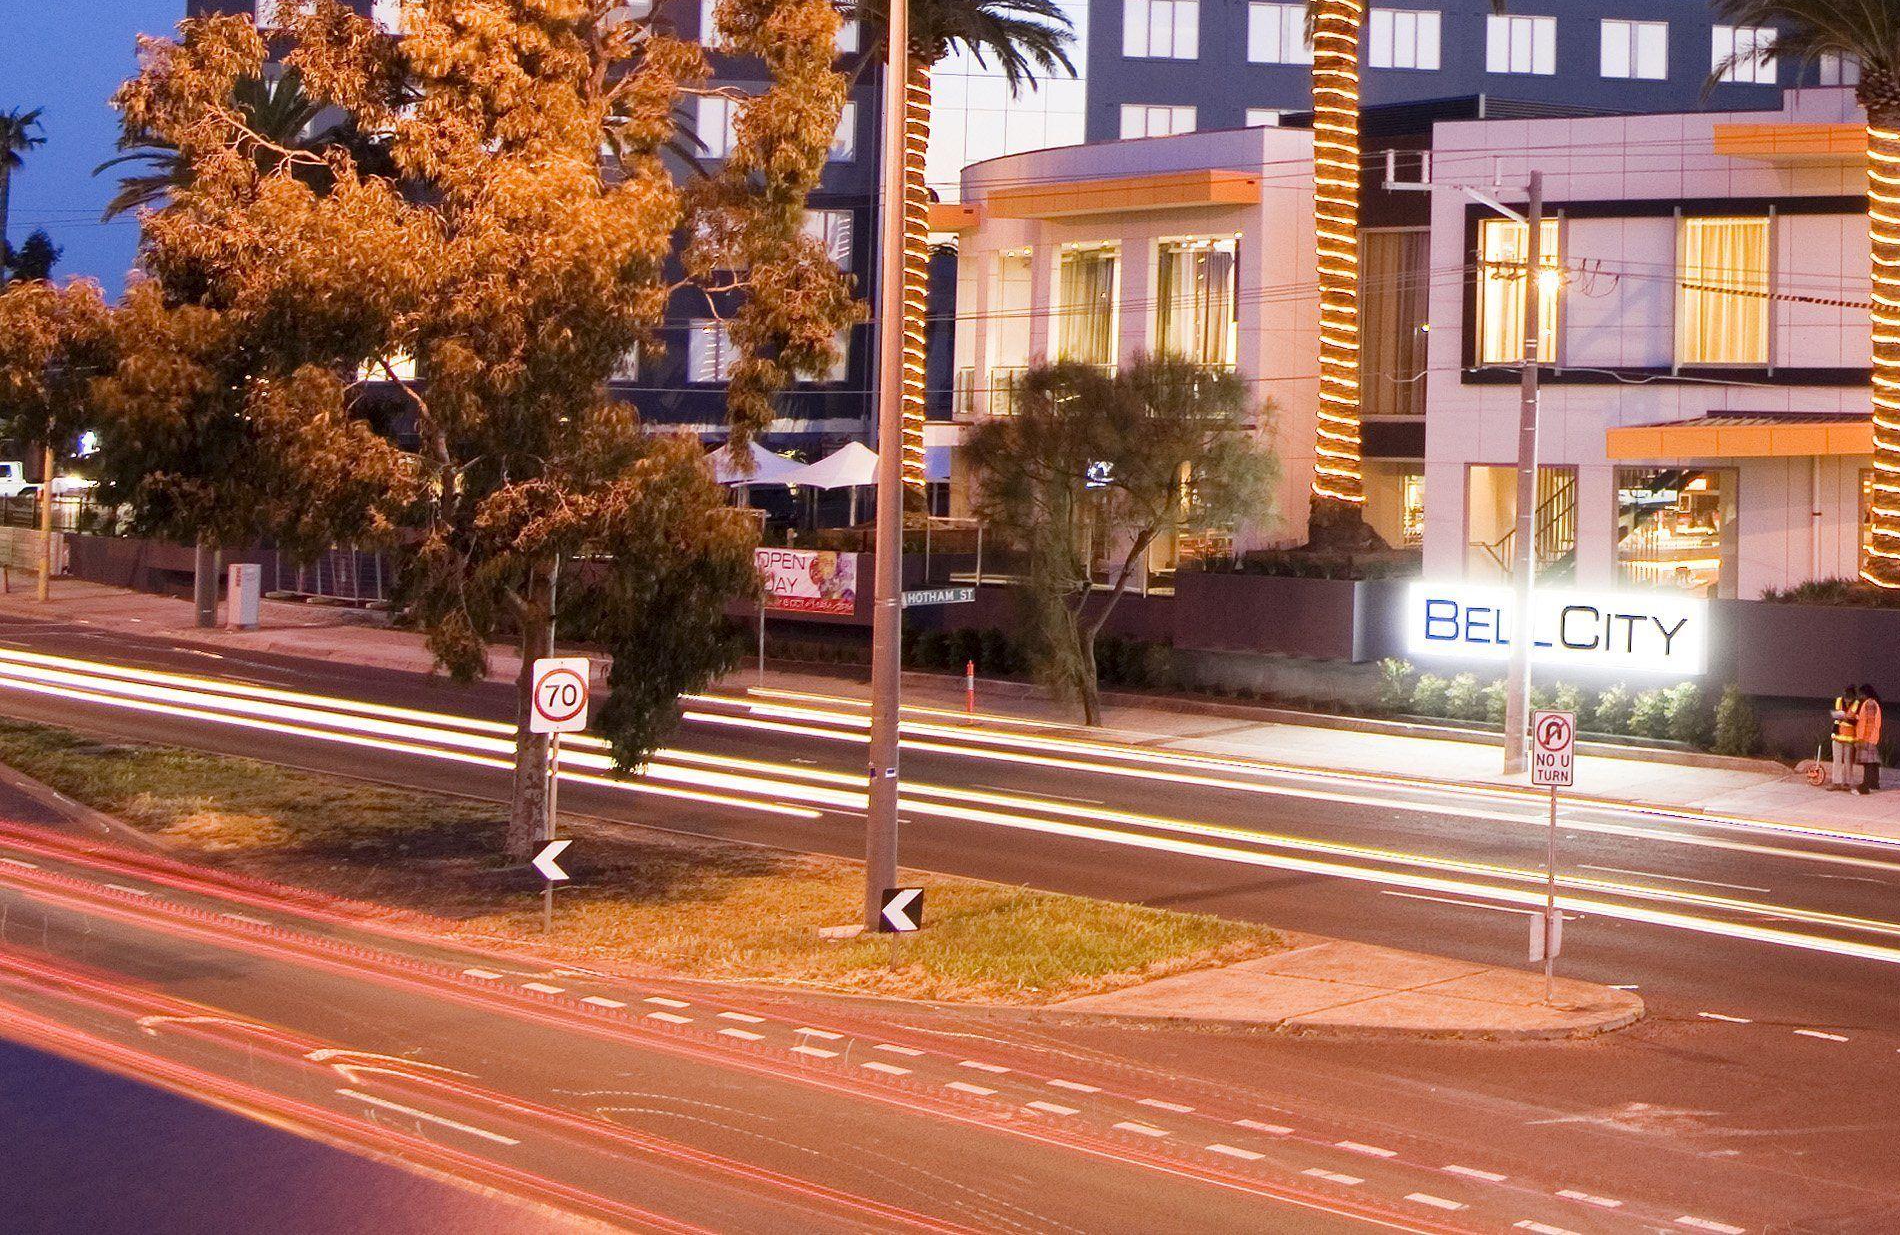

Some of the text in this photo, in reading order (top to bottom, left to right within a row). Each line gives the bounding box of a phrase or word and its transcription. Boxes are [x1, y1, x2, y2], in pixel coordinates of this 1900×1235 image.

[757, 551, 805, 570] OPEN
[907, 590, 973, 604] HOTHAM ST
[1425, 599, 1687, 655] BEL CITY
[545, 683, 577, 707] 70
[1537, 754, 1569, 767] NO U
[1538, 769, 1568, 782] TURN
